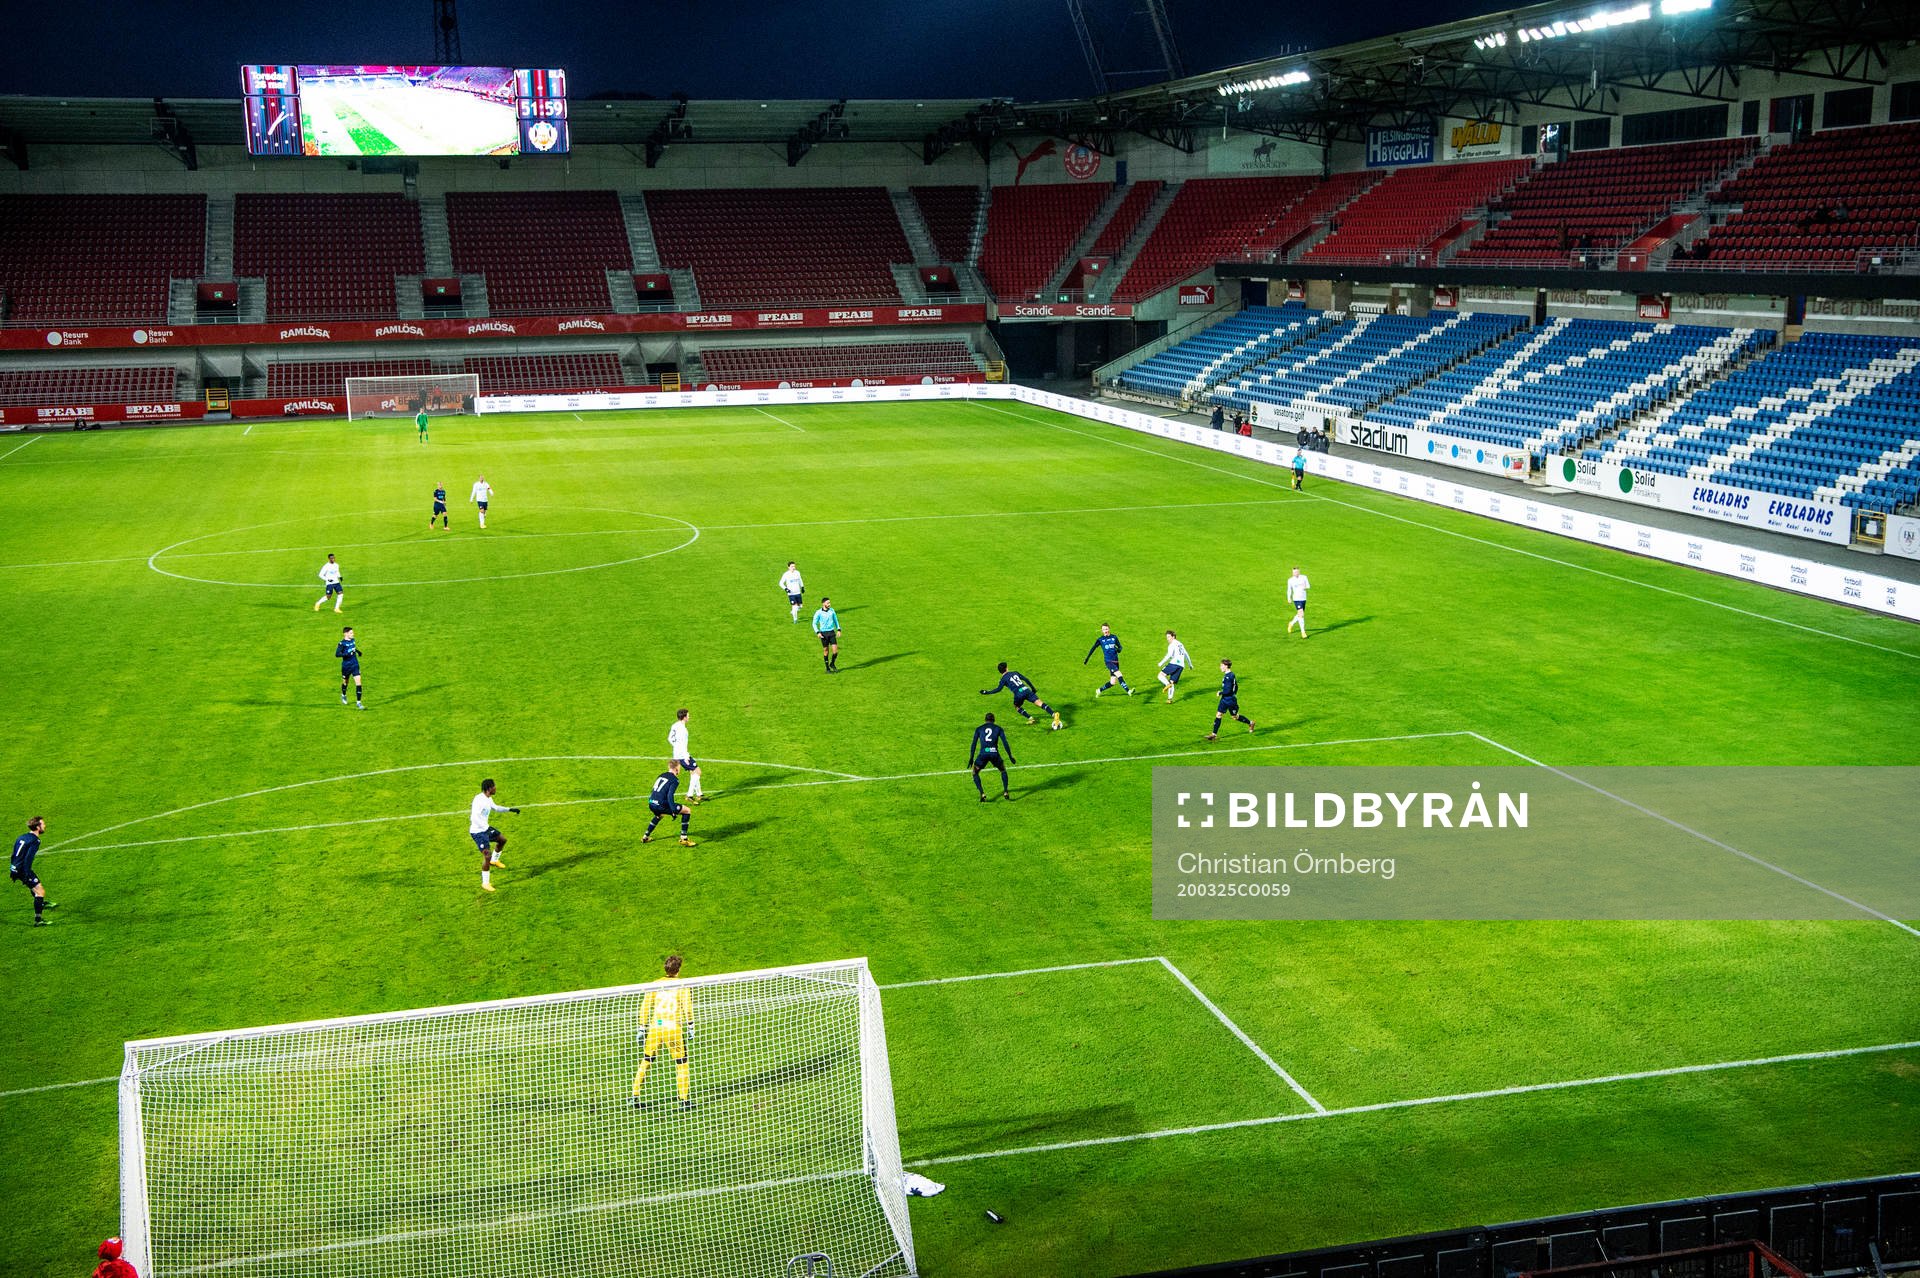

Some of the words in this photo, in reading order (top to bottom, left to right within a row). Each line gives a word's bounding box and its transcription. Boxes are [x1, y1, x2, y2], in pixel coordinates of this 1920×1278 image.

[251, 71, 288, 82] Torsdag
[521, 101, 563, 116] 51:59
[1381, 140, 1430, 162] BYGGPLÅT
[834, 310, 869, 320] PEAB
[904, 308, 938, 318] PEAB
[1015, 305, 1054, 316] Scandic
[1075, 305, 1116, 316] Scandic
[691, 315, 728, 324] PEAB
[764, 313, 799, 322] PEAB
[375, 323, 425, 337] RAMLÖSA
[467, 321, 516, 335] RAMLÖSA
[558, 318, 605, 331] RAMLÖSA
[62, 331, 89, 339] Resurs
[148, 329, 174, 337] Resurs
[280, 325, 331, 340] RAMLÖSA
[864, 378, 886, 386] Resurs
[934, 375, 955, 383] Resurs
[718, 383, 742, 391] Resurs
[791, 381, 813, 389] Resurs
[44, 407, 87, 417] PEAB
[133, 404, 174, 414] PEAB
[1350, 421, 1408, 455] stadium
[1577, 461, 1597, 476] Solid
[1634, 471, 1656, 487] Solid
[1692, 487, 1750, 510] EKBLADHS
[1768, 500, 1834, 526] EKBLADHS
[1010, 674, 1023, 687] 13
[984, 727, 993, 742] 2
[653, 776, 669, 792] 17
